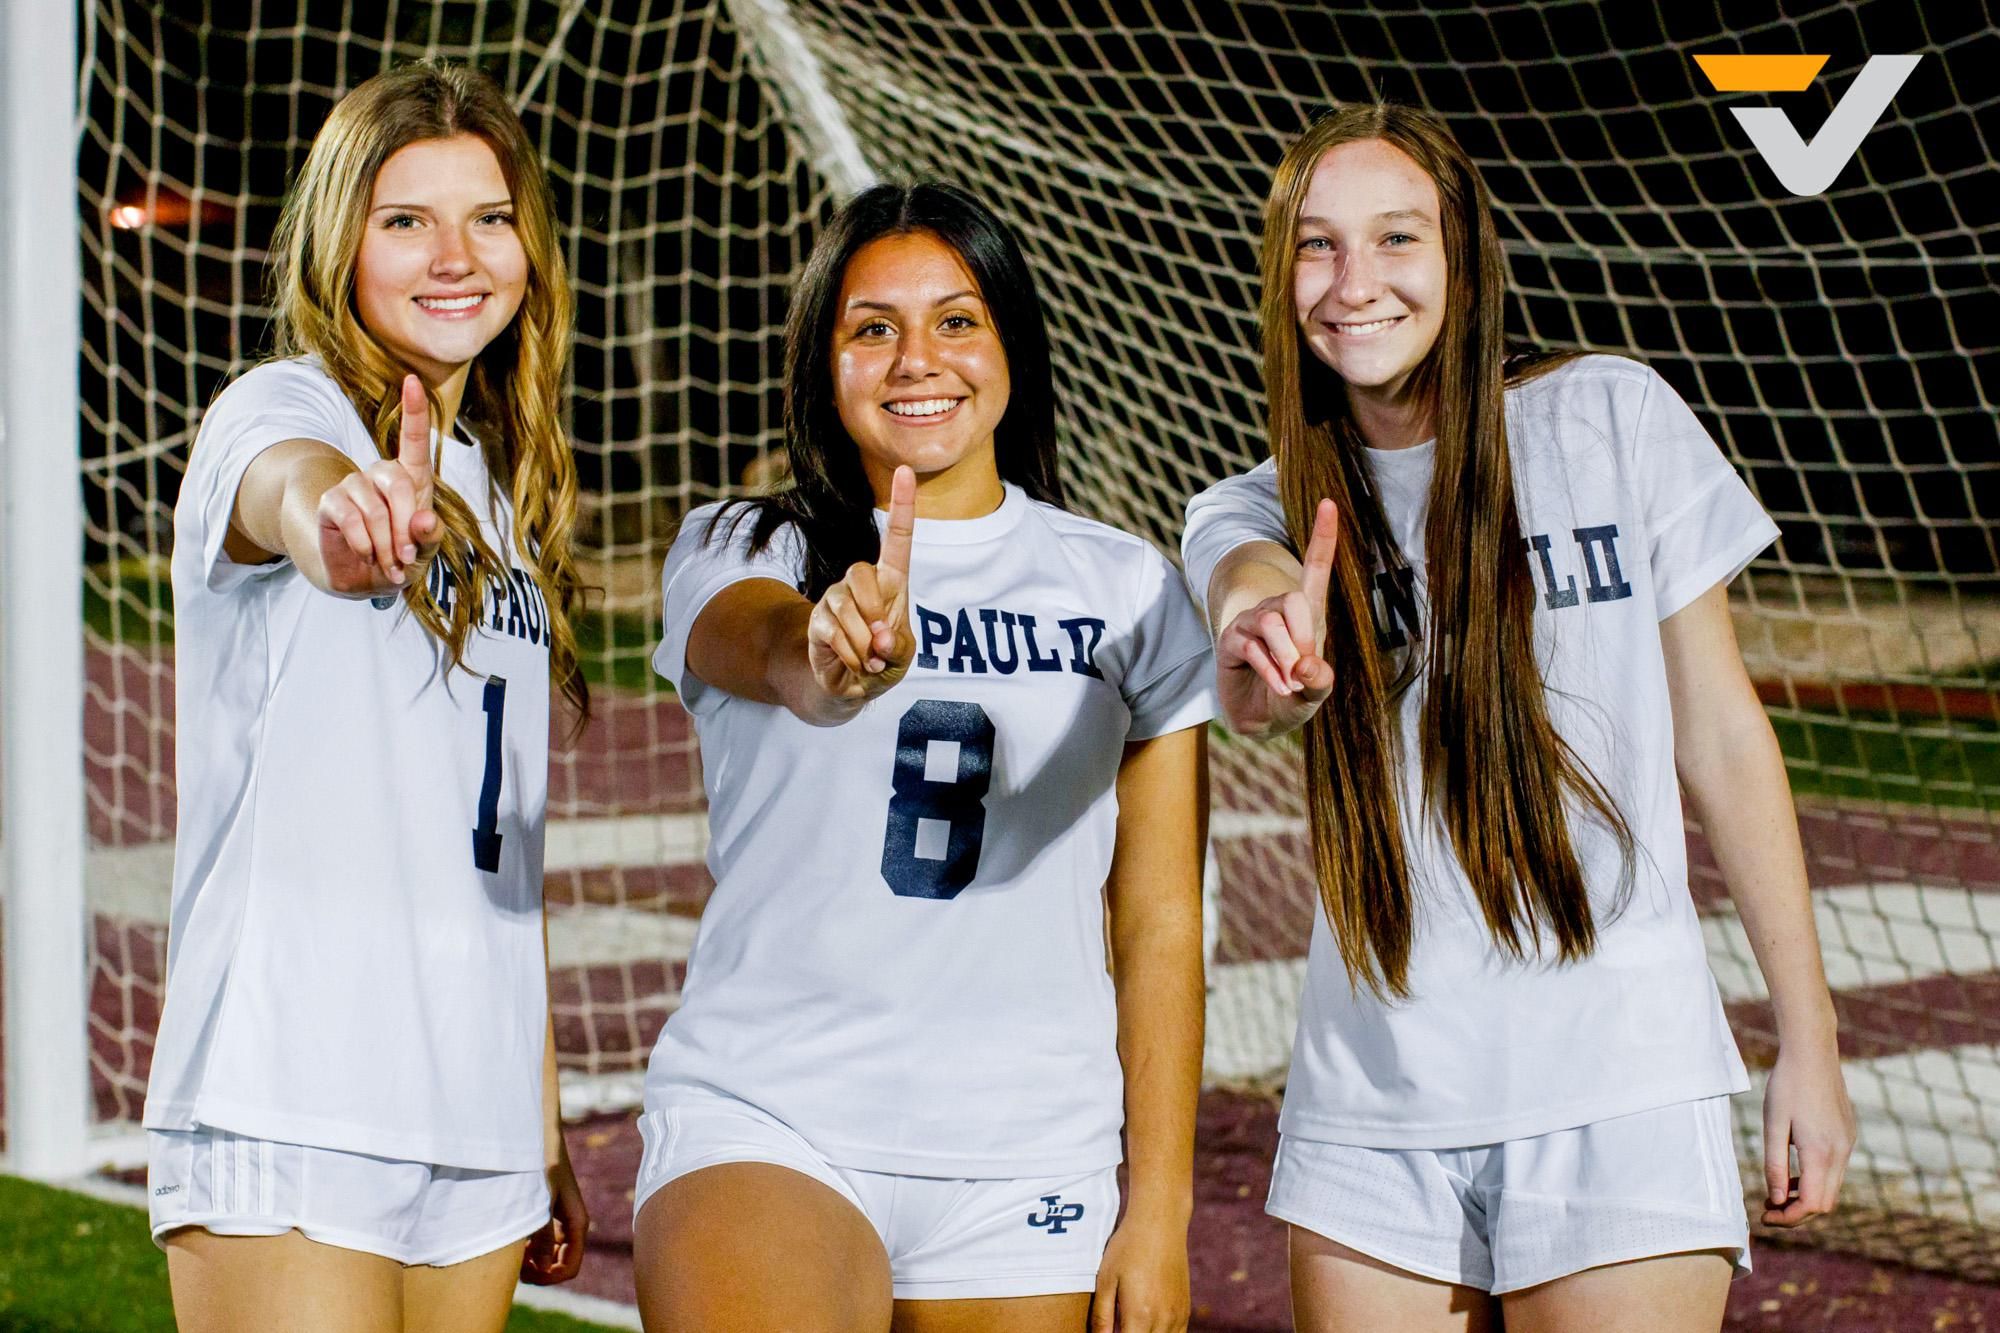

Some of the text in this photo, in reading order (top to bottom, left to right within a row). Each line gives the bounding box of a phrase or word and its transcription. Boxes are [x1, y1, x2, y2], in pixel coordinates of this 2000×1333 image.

[916, 604, 1063, 674] PAUL
[472, 674, 507, 874] 1
[880, 699, 996, 901] 8
